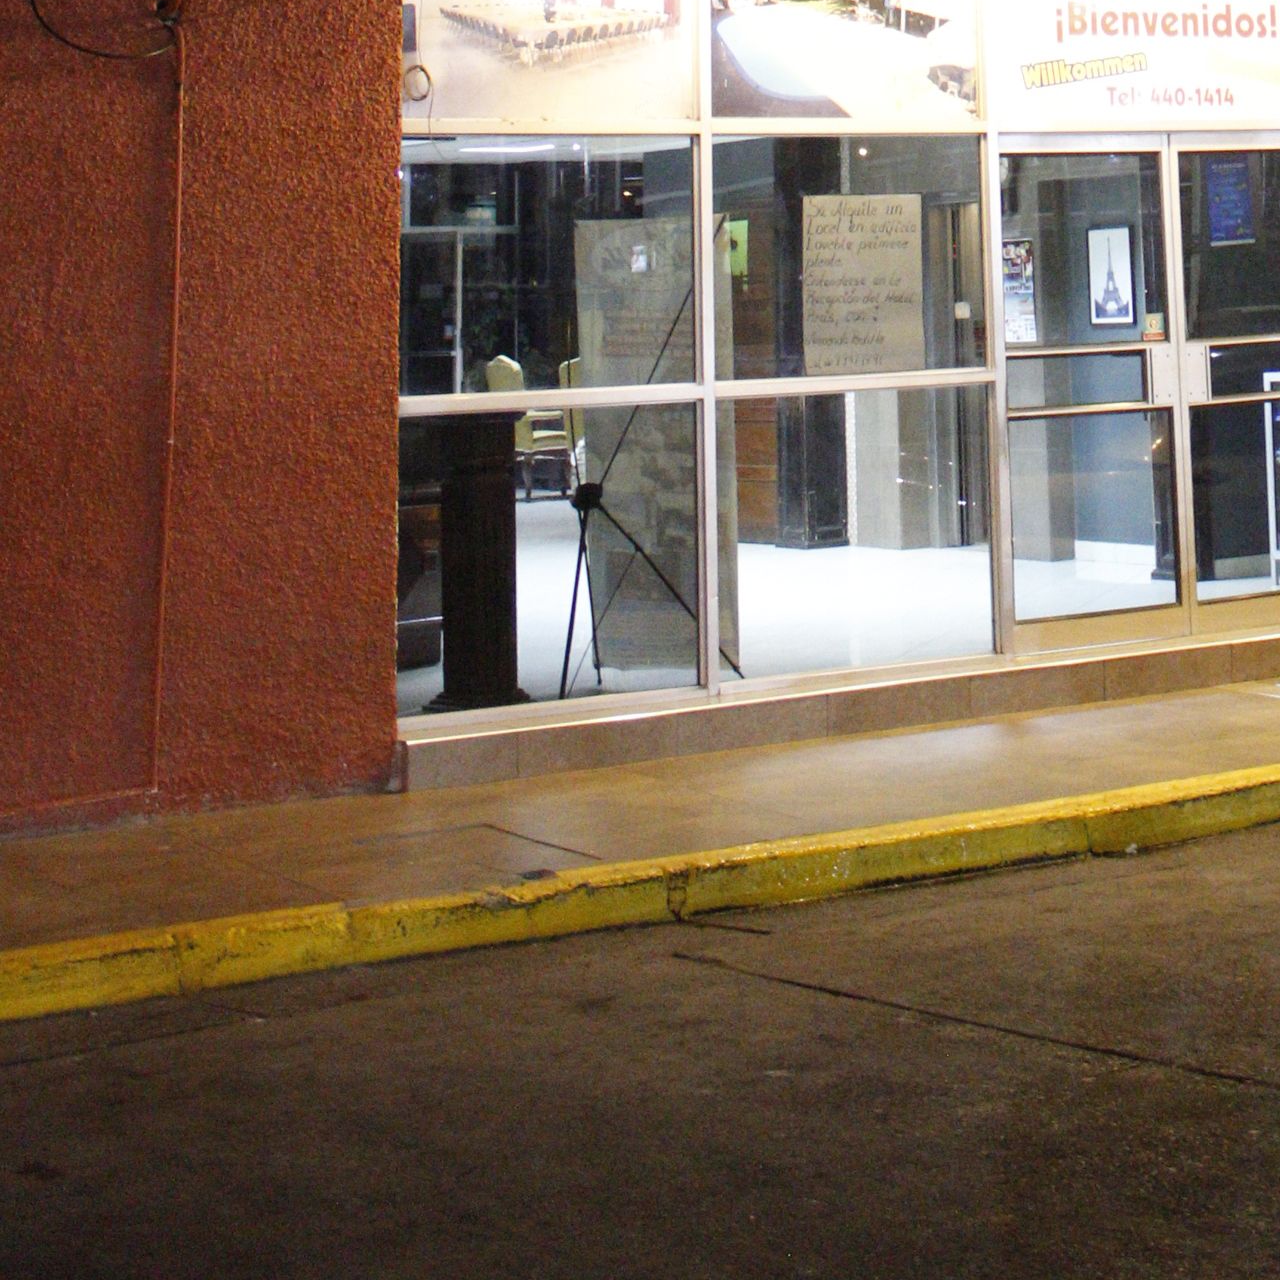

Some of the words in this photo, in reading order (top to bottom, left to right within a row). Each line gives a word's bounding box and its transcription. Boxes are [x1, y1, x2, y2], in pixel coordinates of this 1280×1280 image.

[1056, 0, 1278, 44] ¡Bienvenidos!
[1021, 52, 1148, 90] Willkommen
[1151, 87, 1235, 107] 440-1414
